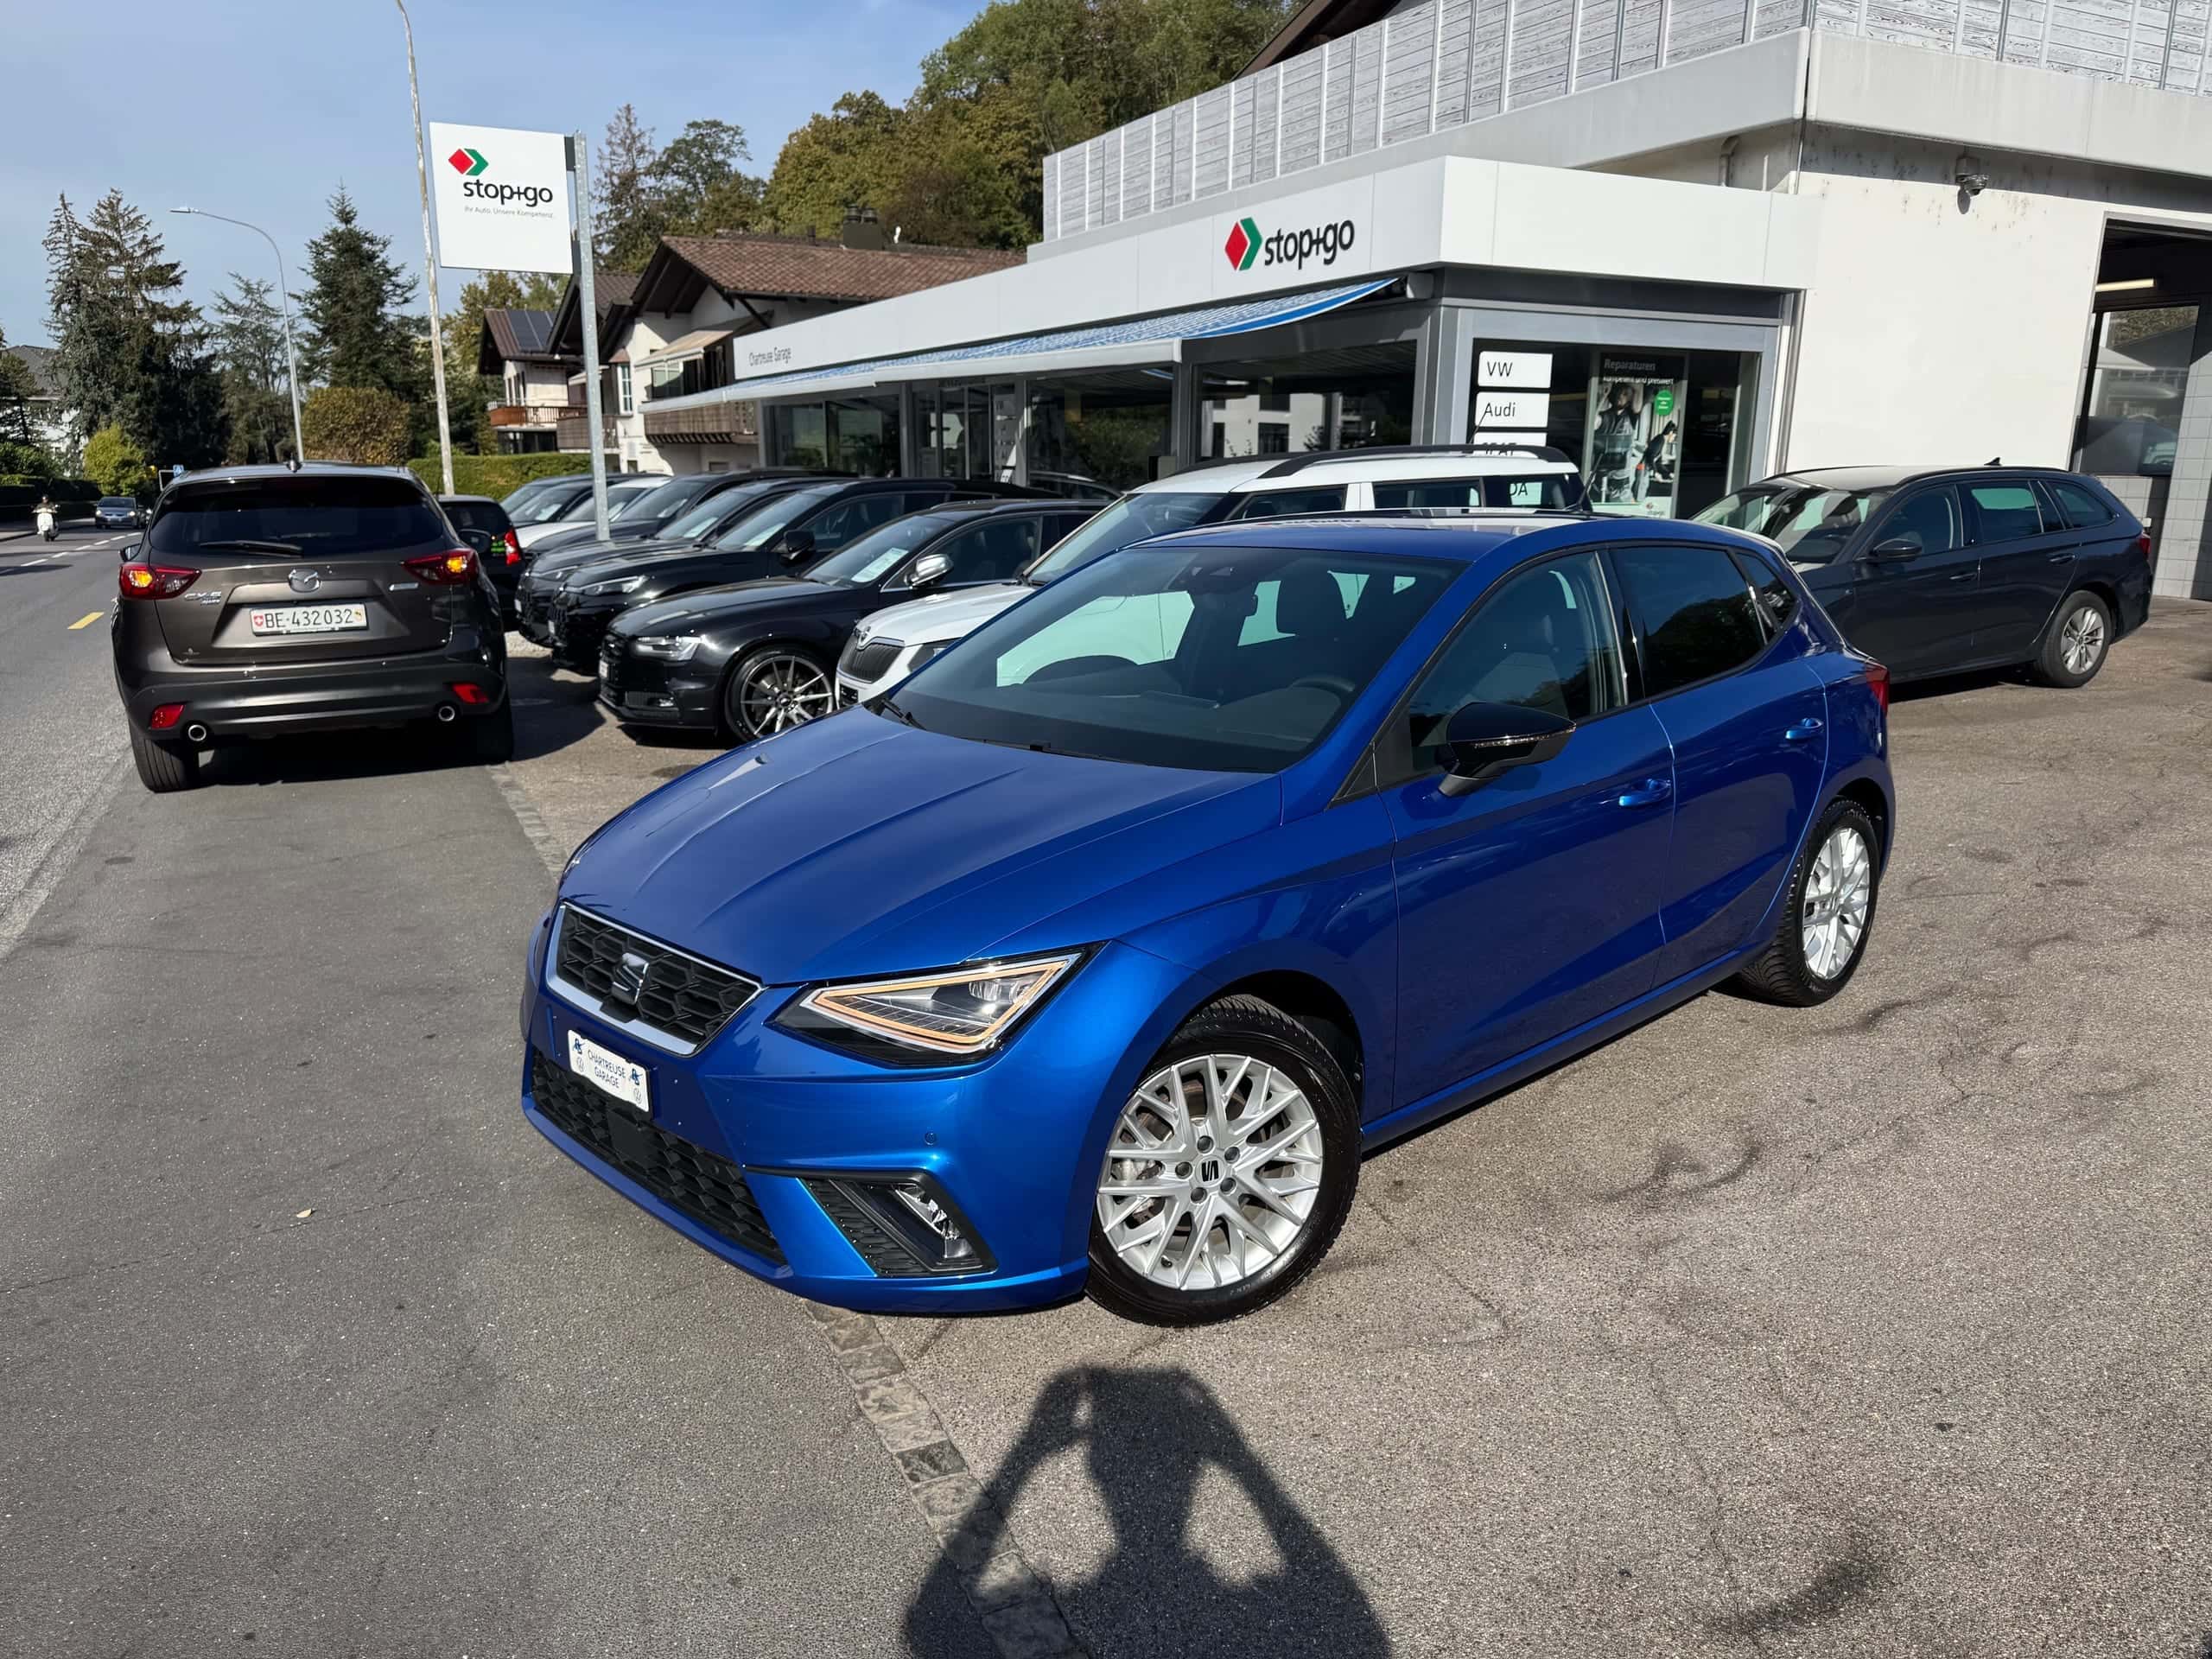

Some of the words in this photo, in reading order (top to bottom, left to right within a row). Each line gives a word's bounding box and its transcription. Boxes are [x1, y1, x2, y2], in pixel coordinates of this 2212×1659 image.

[463, 179, 553, 207] stop+go
[1264, 219, 1355, 270] stop+go
[1487, 361, 1513, 377] VW
[1605, 359, 1656, 372] Reparaturen
[1484, 403, 1516, 416] Audi
[588, 1049, 626, 1078] CHARTREUSE
[594, 1071, 620, 1089] GARAGE
